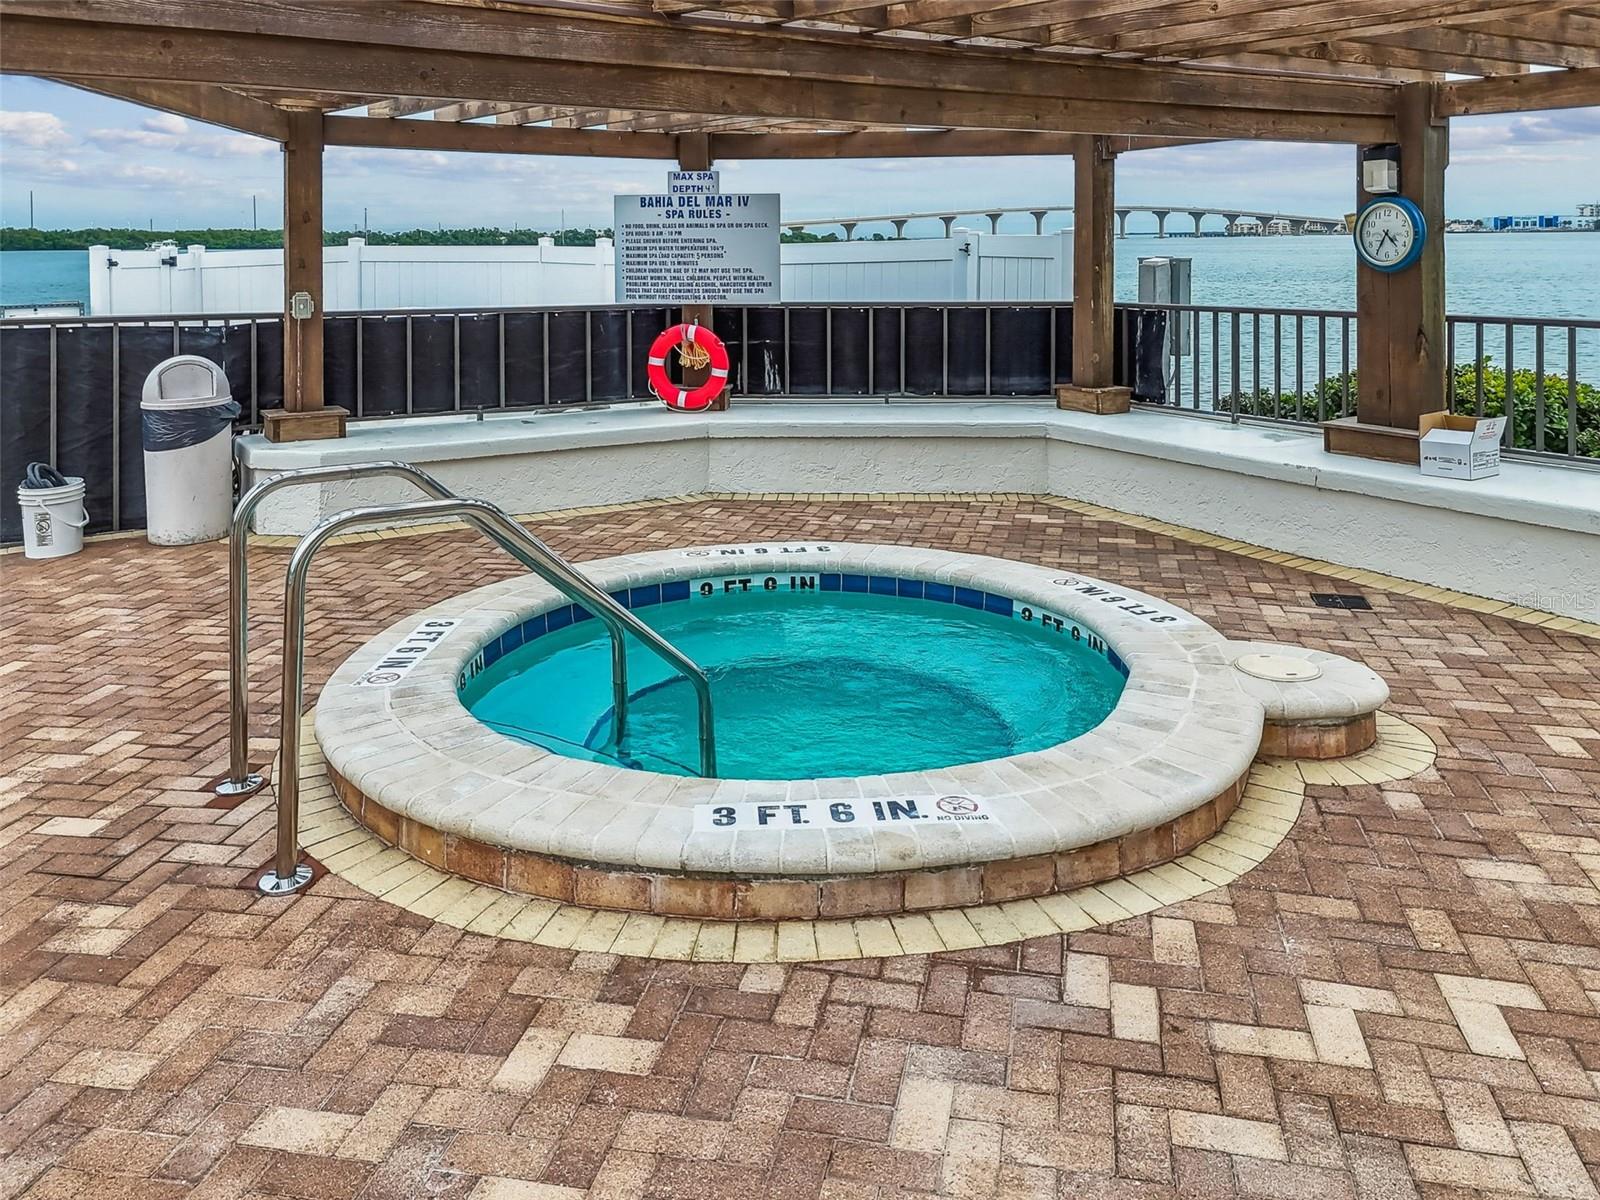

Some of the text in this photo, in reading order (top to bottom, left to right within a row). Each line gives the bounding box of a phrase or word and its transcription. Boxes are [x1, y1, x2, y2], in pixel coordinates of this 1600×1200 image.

[640, 196, 749, 208] BAHIA DEL MAR IV
[665, 210, 684, 219] SPA
[688, 210, 721, 218] RULES
[791, 576, 814, 589] IN
[1088, 633, 1102, 654] IN
[712, 800, 928, 826] 3 FT. 6 IN.
